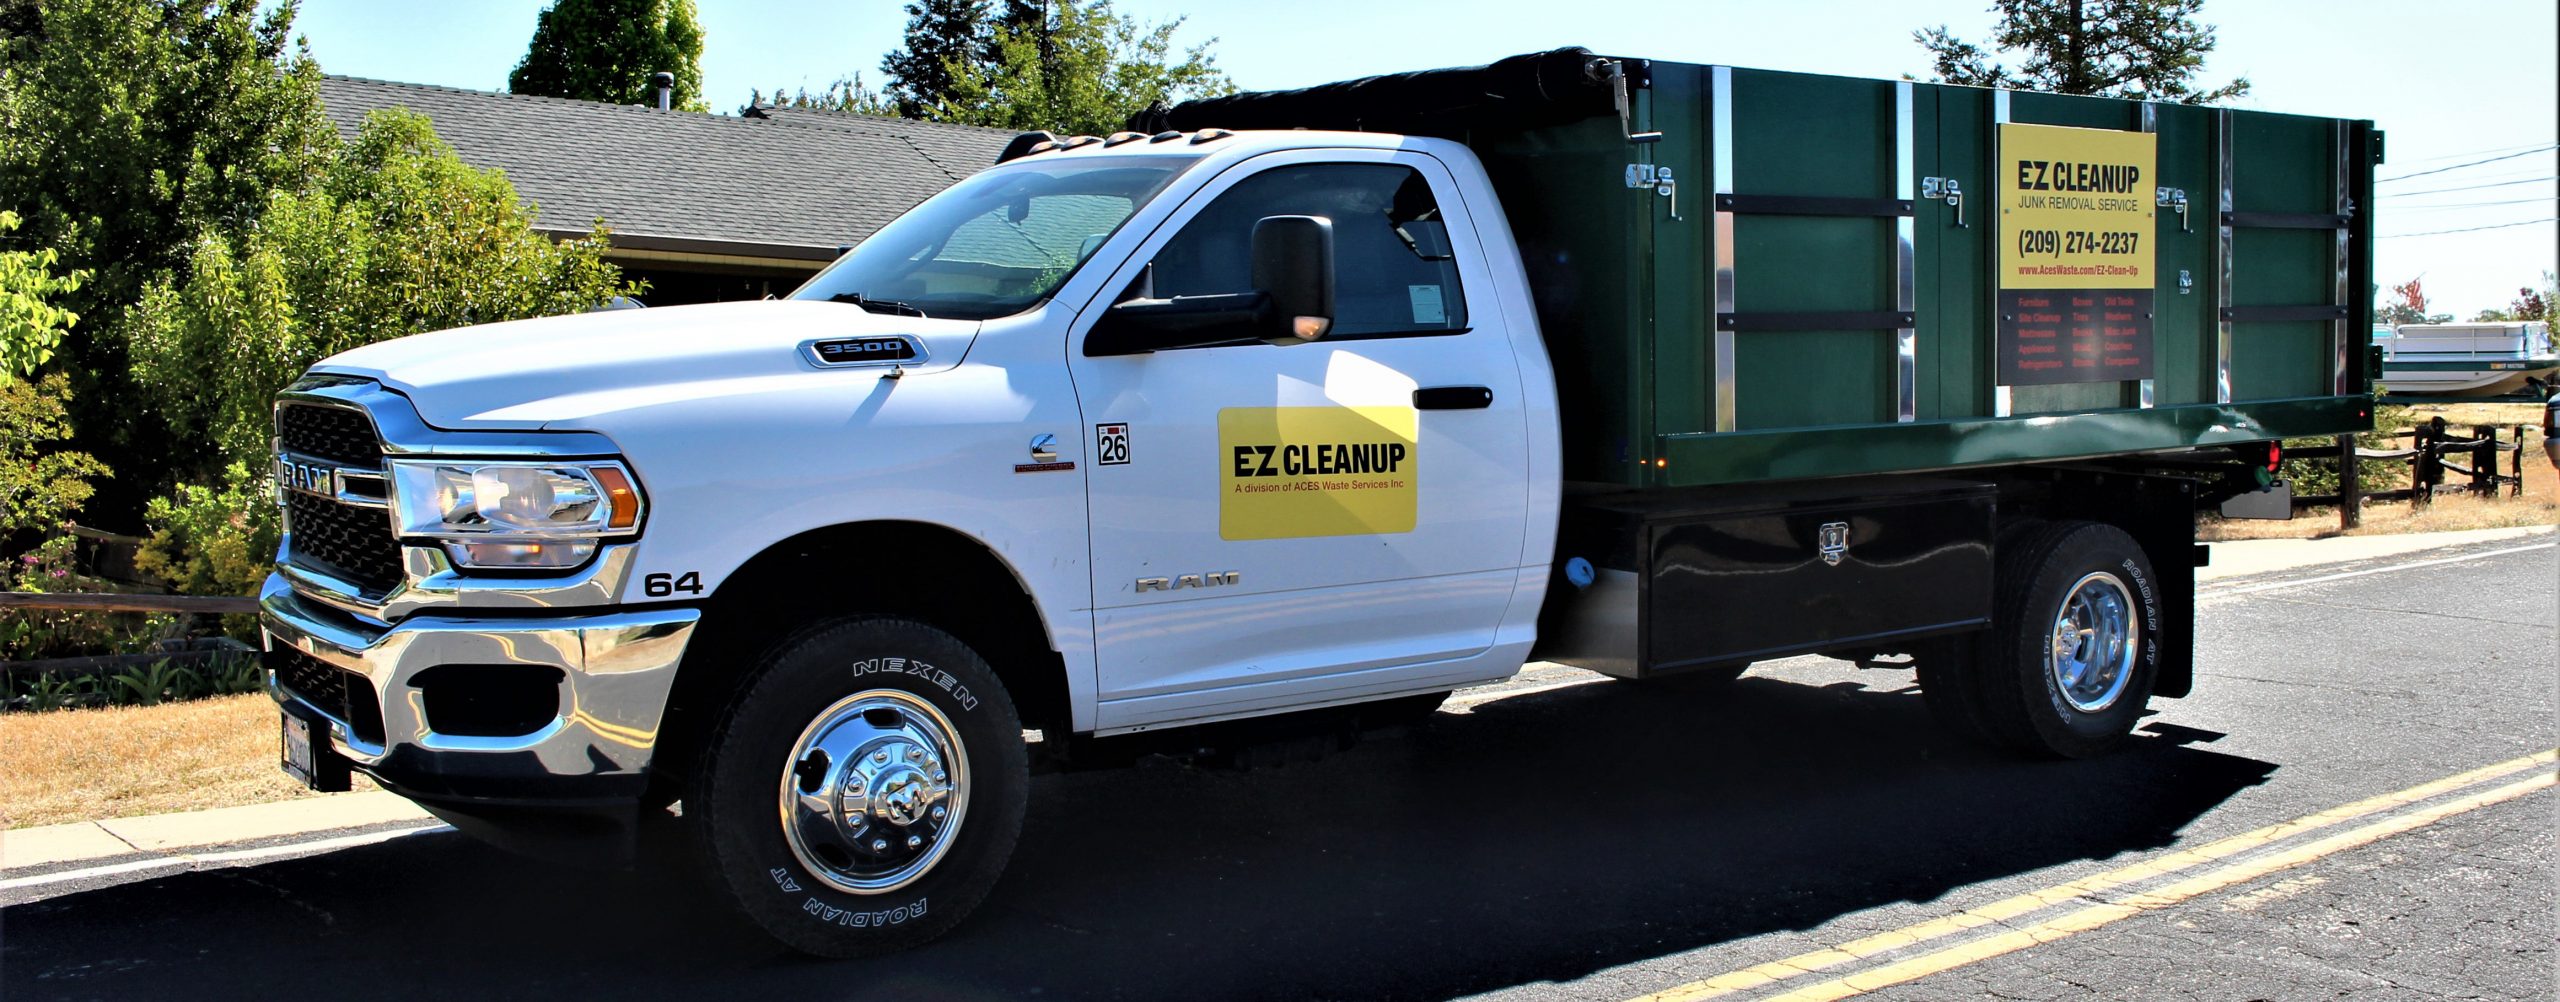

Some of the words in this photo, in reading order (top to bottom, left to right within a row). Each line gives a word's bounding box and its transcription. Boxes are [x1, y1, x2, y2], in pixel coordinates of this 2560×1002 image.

[2018, 160, 2049, 190] EZ
[2053, 161, 2139, 194] CLEANUP
[2018, 195, 2046, 209] JUNK
[2048, 196, 2096, 211] REMOVAL
[2098, 198, 2138, 212] SERVICE
[2018, 229, 2061, 258] (209)
[2065, 231, 2138, 255] 274-2237
[2018, 264, 2138, 277] www.AcesWaste.com/EZ-Clean-Up
[822, 341, 903, 354] 3500
[1101, 434, 1127, 462] 26
[1233, 445, 1278, 477] EZ
[1283, 442, 1406, 476] CLEANUP
[280, 459, 332, 496] RAM
[1235, 483, 1242, 493] A
[1244, 482, 1280, 493] division
[1282, 481, 1292, 492] of
[1294, 480, 1320, 491] ACES
[1322, 480, 1350, 490] Waste
[1352, 479, 1389, 490] Services
[1391, 478, 1404, 489] Inc
[644, 571, 704, 598] 64
[1135, 570, 1240, 594] RAM
[2122, 558, 2157, 631] ROADIAN
[853, 656, 979, 712] NEXEN
[770, 866, 803, 893] AT
[803, 896, 928, 928] ROADIAN
